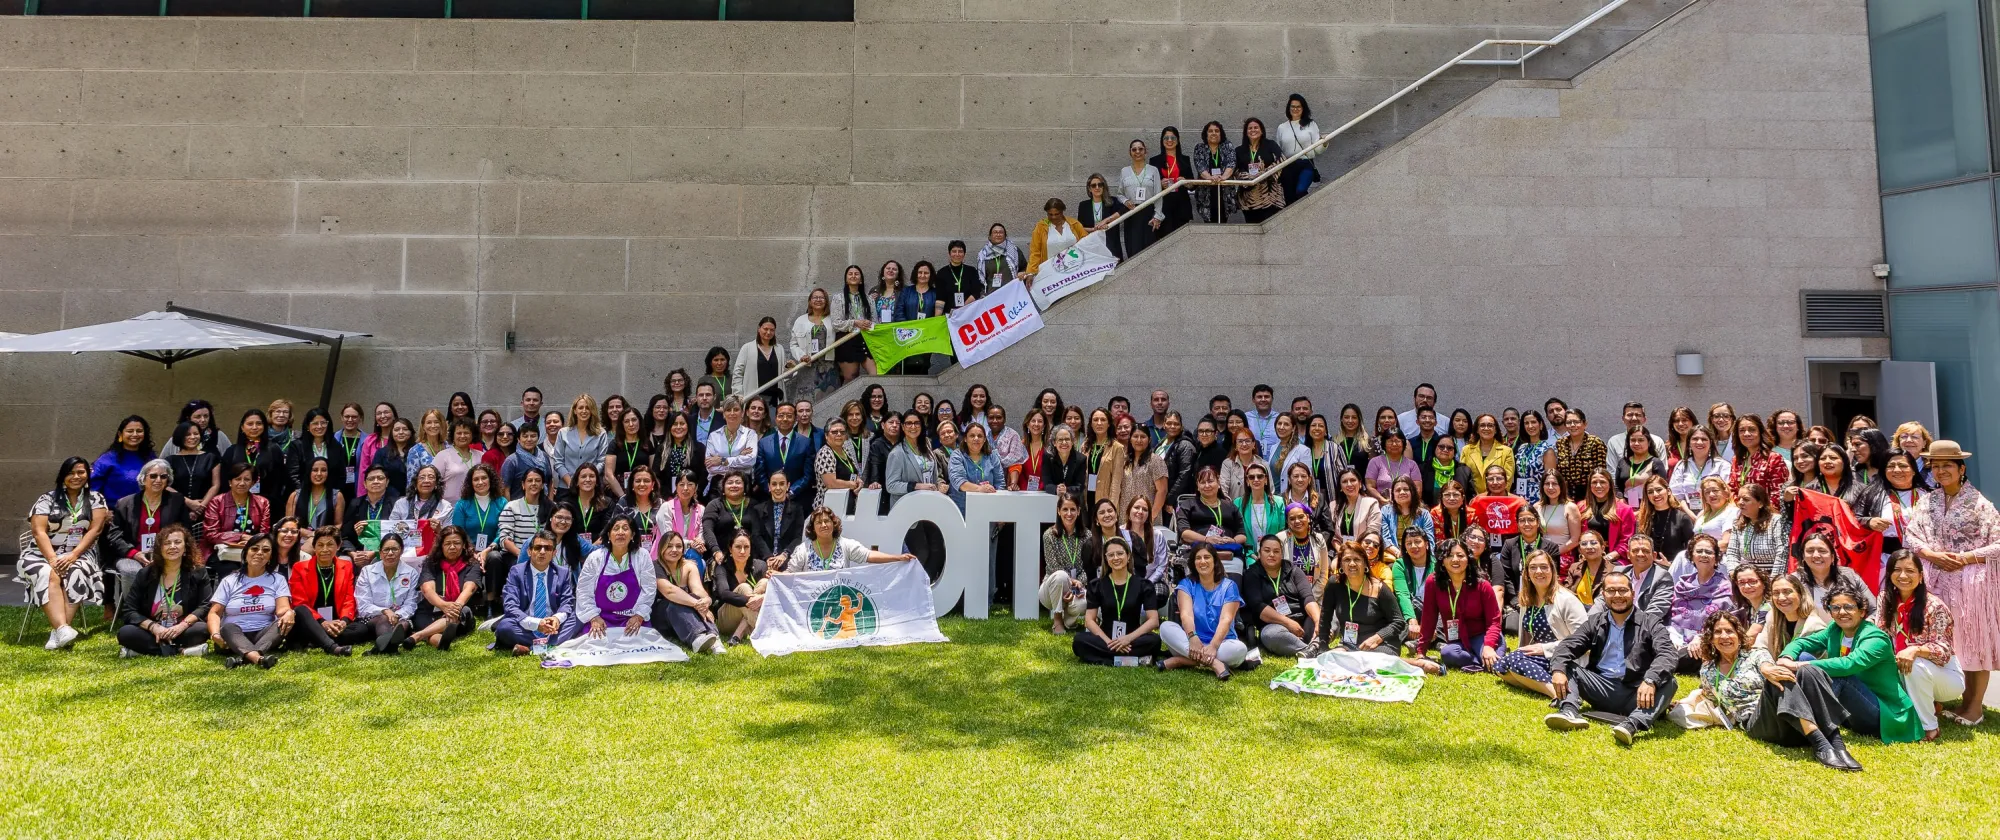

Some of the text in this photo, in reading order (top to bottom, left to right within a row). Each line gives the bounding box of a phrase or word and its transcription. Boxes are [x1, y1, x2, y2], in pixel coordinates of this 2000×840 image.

[958, 304, 1009, 347] CUT
[1008, 300, 1029, 320] Chile
[1487, 519, 1512, 529] CATP
